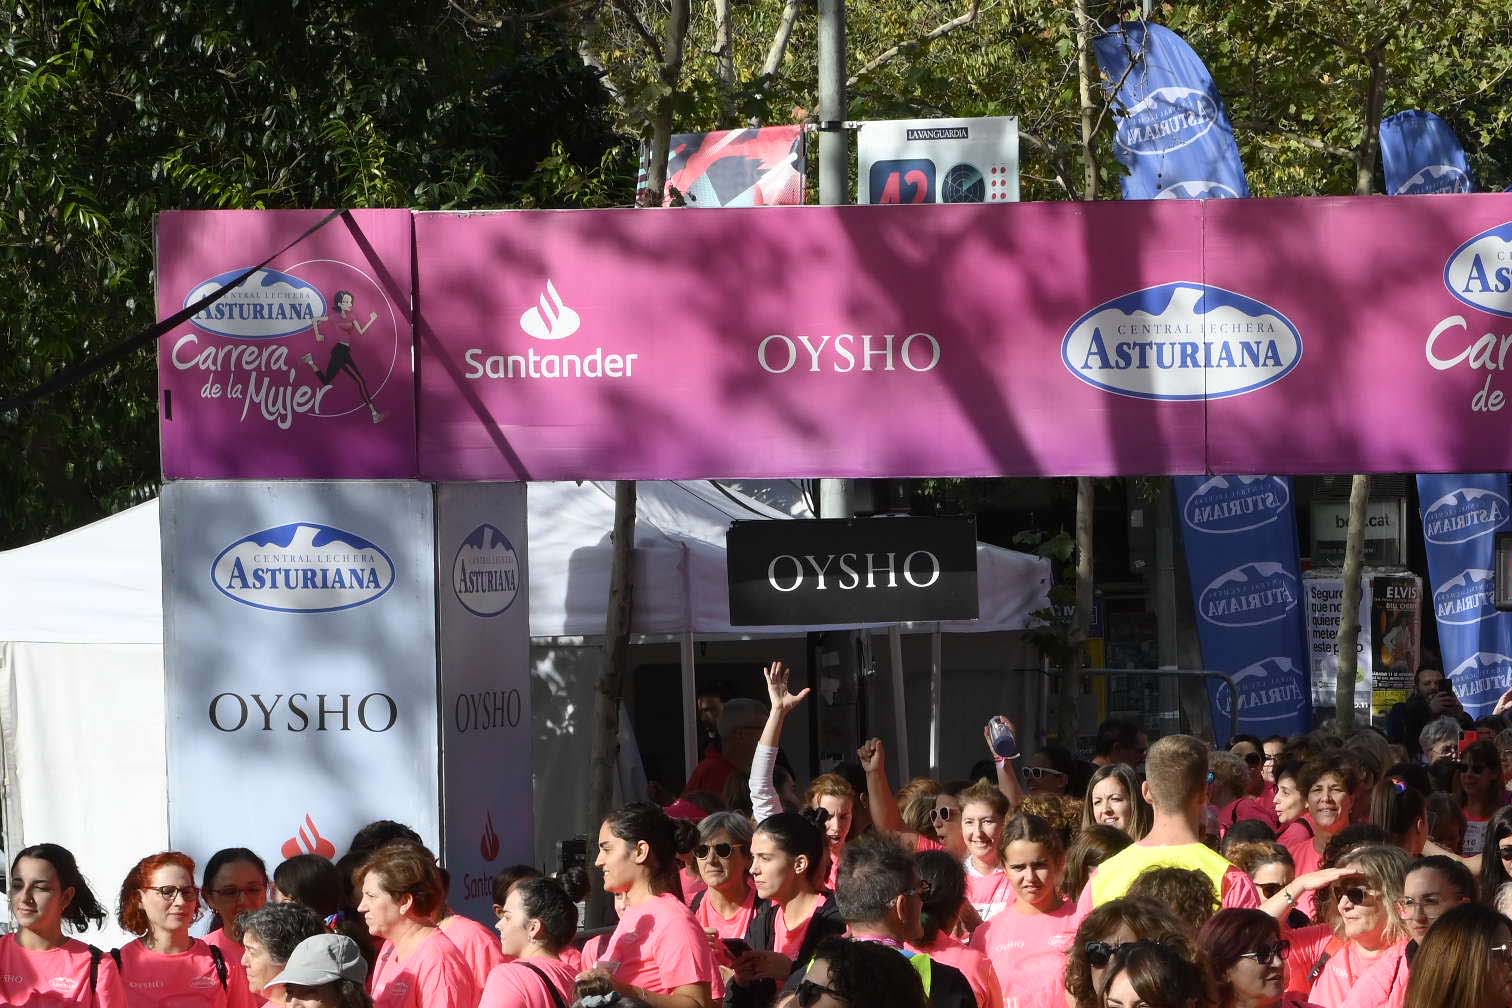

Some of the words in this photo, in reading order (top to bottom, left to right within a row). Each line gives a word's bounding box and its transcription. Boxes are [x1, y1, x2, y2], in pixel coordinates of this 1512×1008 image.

[918, 129, 967, 139] VANGUARDIA
[222, 291, 261, 299] ENTRAL
[262, 290, 311, 299] LECHERA
[1118, 323, 1193, 335] CENTRAL
[1200, 322, 1276, 334] LECHERA
[172, 333, 289, 372] Carrera
[465, 347, 638, 380] Santander
[757, 332, 941, 373] OYSHO
[1081, 325, 1285, 370] ASTURIANA
[201, 373, 222, 399] de
[227, 373, 243, 399] la
[240, 370, 334, 430] Mujer
[1471, 373, 1506, 413] de
[225, 555, 383, 590] ASTURIANA
[253, 554, 313, 564] CENTRAL
[317, 553, 376, 564] LECHERA
[766, 550, 941, 592] OYSHO
[459, 565, 517, 594] ASTURIANA
[1386, 586, 1417, 599] ELVIS
[1311, 603, 1329, 614] que
[1313, 642, 1333, 653] este
[208, 692, 398, 733] OYSHO
[455, 689, 521, 734] OYSHO
